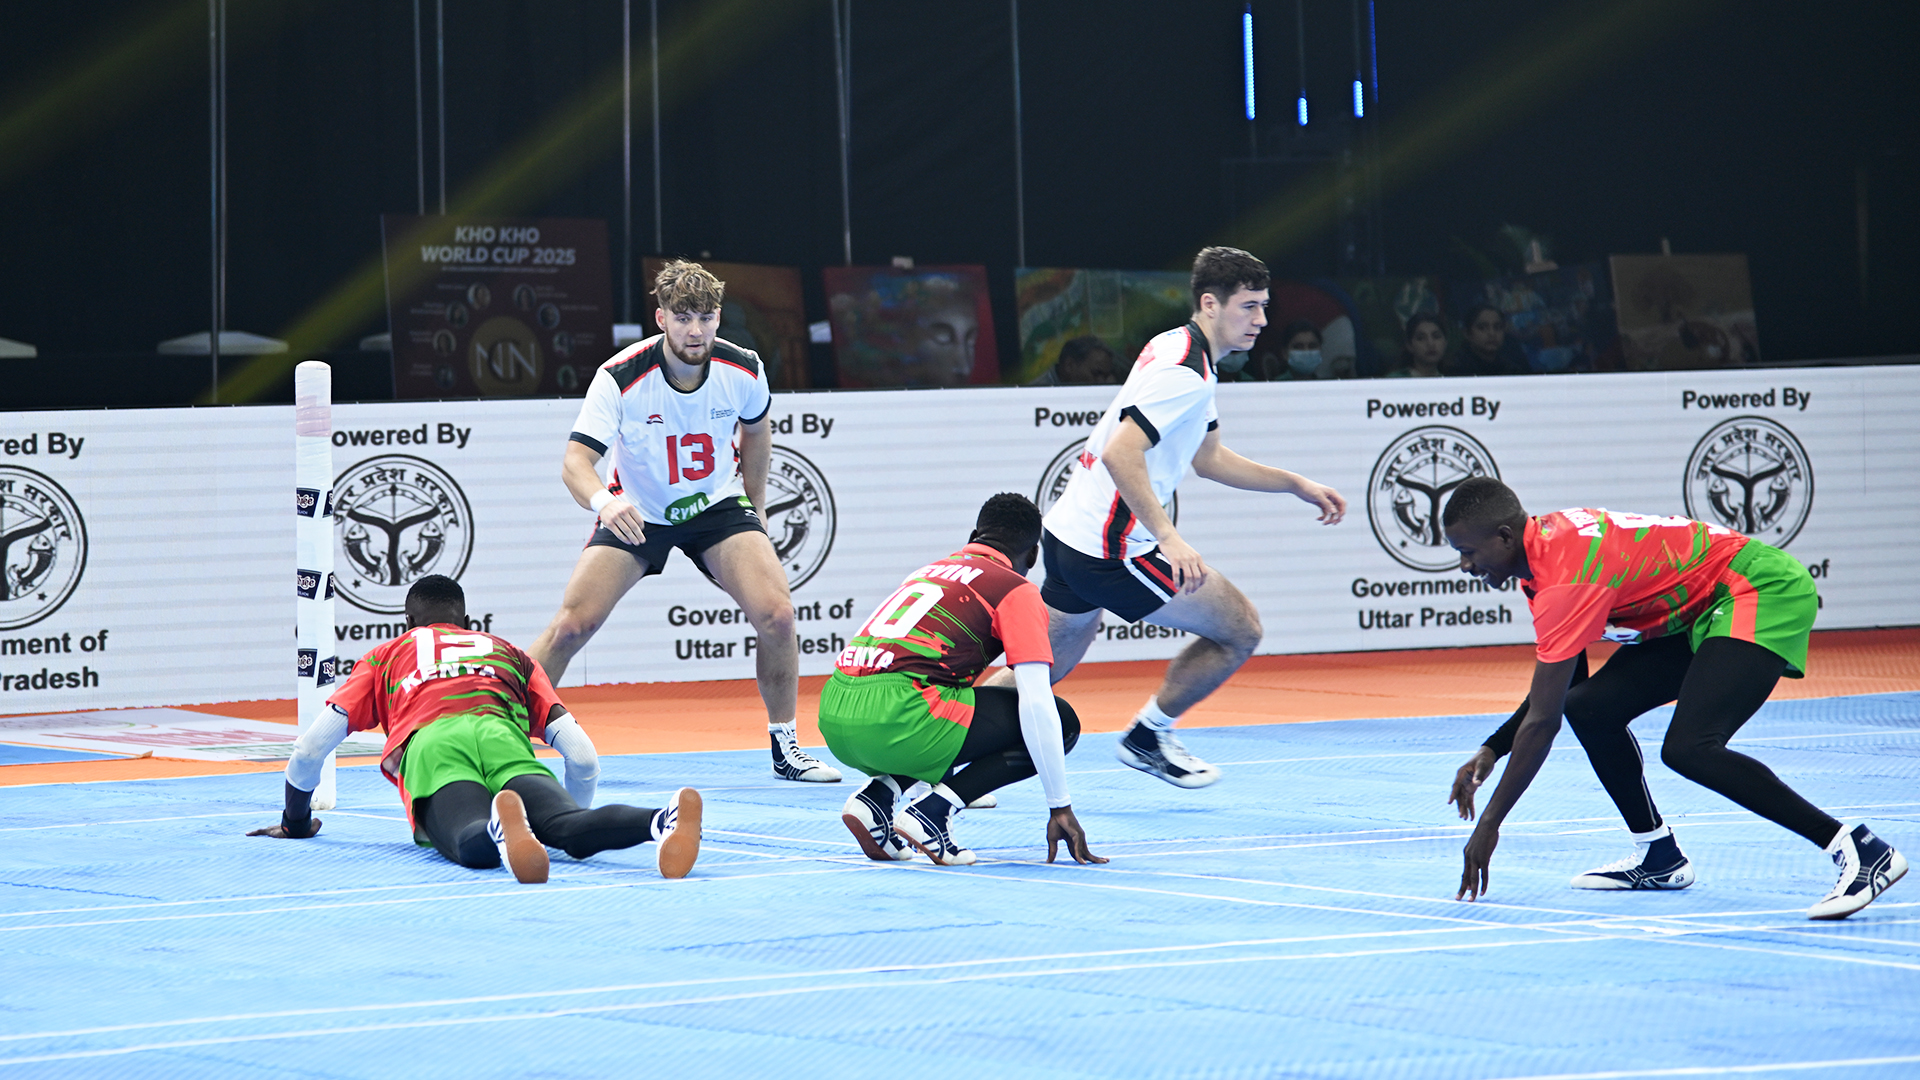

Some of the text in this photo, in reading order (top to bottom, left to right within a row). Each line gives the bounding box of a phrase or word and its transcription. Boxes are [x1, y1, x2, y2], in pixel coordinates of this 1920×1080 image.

[454, 226, 540, 245] KHO KHO
[421, 245, 576, 265] WORLD CUP 2025
[1367, 396, 1501, 420] Powered By
[1682, 387, 1811, 411] Powered By
[802, 413, 834, 439] By
[1035, 407, 1105, 428] Powe
[48, 432, 84, 459] By
[331, 423, 471, 449] owered By
[666, 433, 715, 485] 13
[1765, 432, 1801, 481] सरकार
[415, 472, 459, 528] सरकार
[781, 461, 822, 515] सरकार
[24, 483, 72, 541] सरकार
[669, 497, 706, 521] RYNA
[1808, 559, 1830, 579] of
[470, 613, 493, 632] of
[668, 598, 854, 627] Governnt of
[1358, 603, 1512, 630] Uttar Pradesh
[80, 630, 109, 652] of
[411, 627, 493, 670] 12
[675, 632, 845, 660] Uttar Pesh
[836, 645, 895, 669] KENYA
[0, 667, 98, 691] radesh
[400, 662, 498, 694] KENYA
